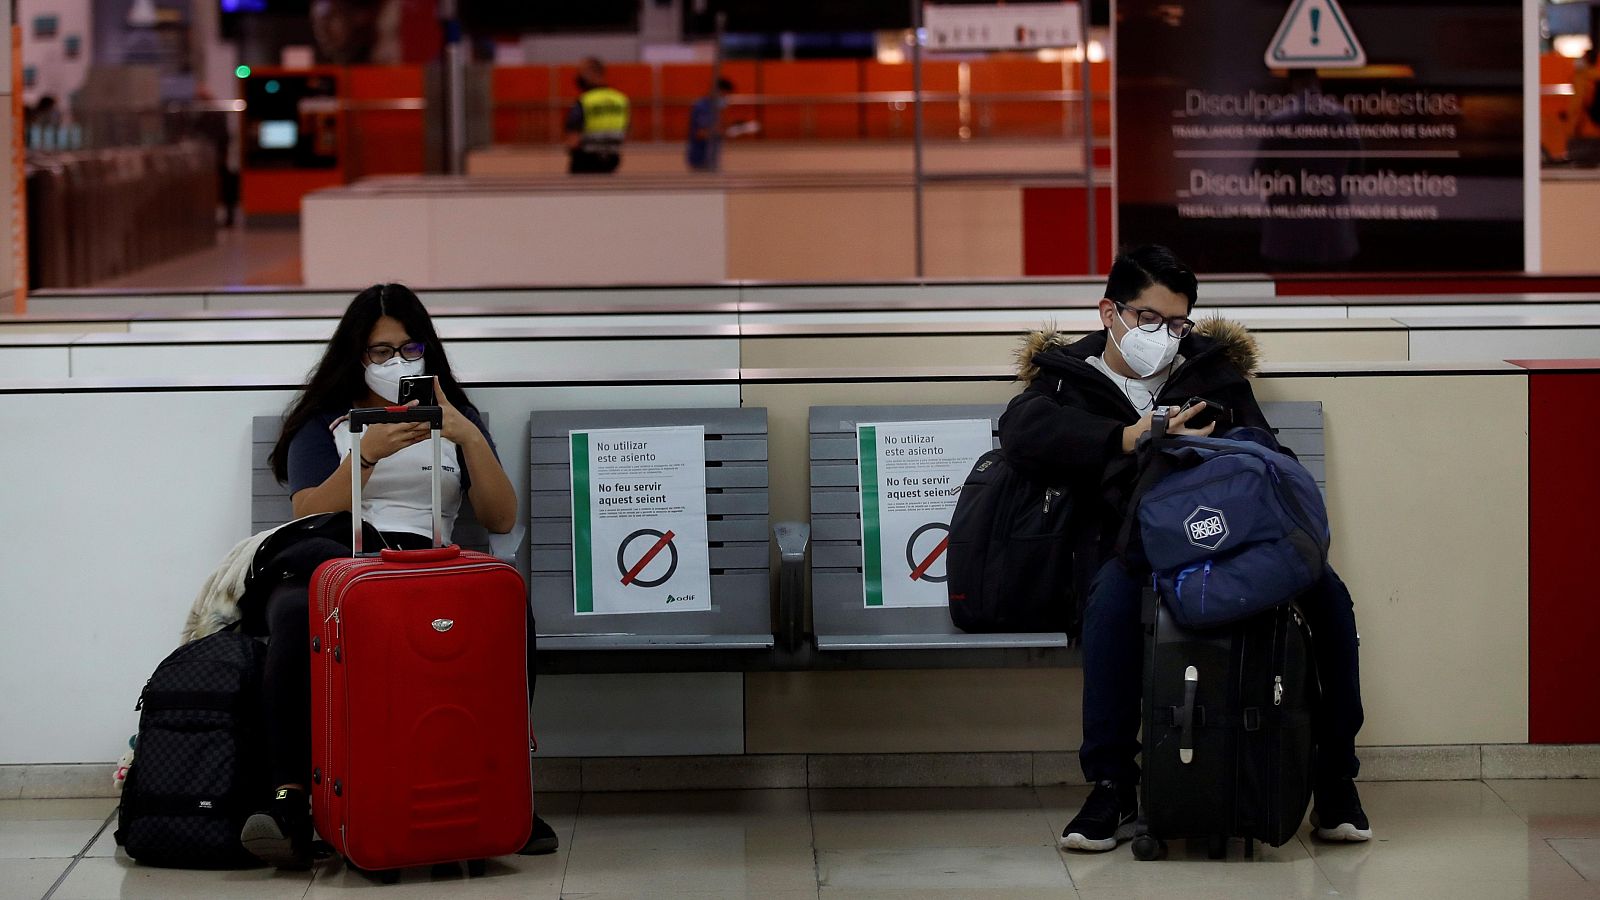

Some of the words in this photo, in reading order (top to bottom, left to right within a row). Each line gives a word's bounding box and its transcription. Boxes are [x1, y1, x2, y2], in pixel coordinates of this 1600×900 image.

[1304, 87, 1338, 115] las
[1301, 168, 1336, 196] les
[1341, 168, 1457, 196] molèsties
[885, 435, 897, 444] No
[901, 434, 935, 444] utilizar
[597, 442, 610, 451] No
[613, 440, 647, 451] utilizar
[885, 448, 905, 457] este
[908, 446, 944, 456] asiento
[597, 454, 617, 463] este
[620, 452, 656, 462] asiento
[886, 477, 900, 487] No
[903, 476, 919, 486] feu
[922, 475, 950, 485] servir
[598, 483, 612, 493] No
[615, 482, 631, 492] feu
[634, 481, 662, 492] servir
[599, 495, 633, 506] aquest
[635, 494, 667, 504] seient
[887, 489, 921, 500] aquest
